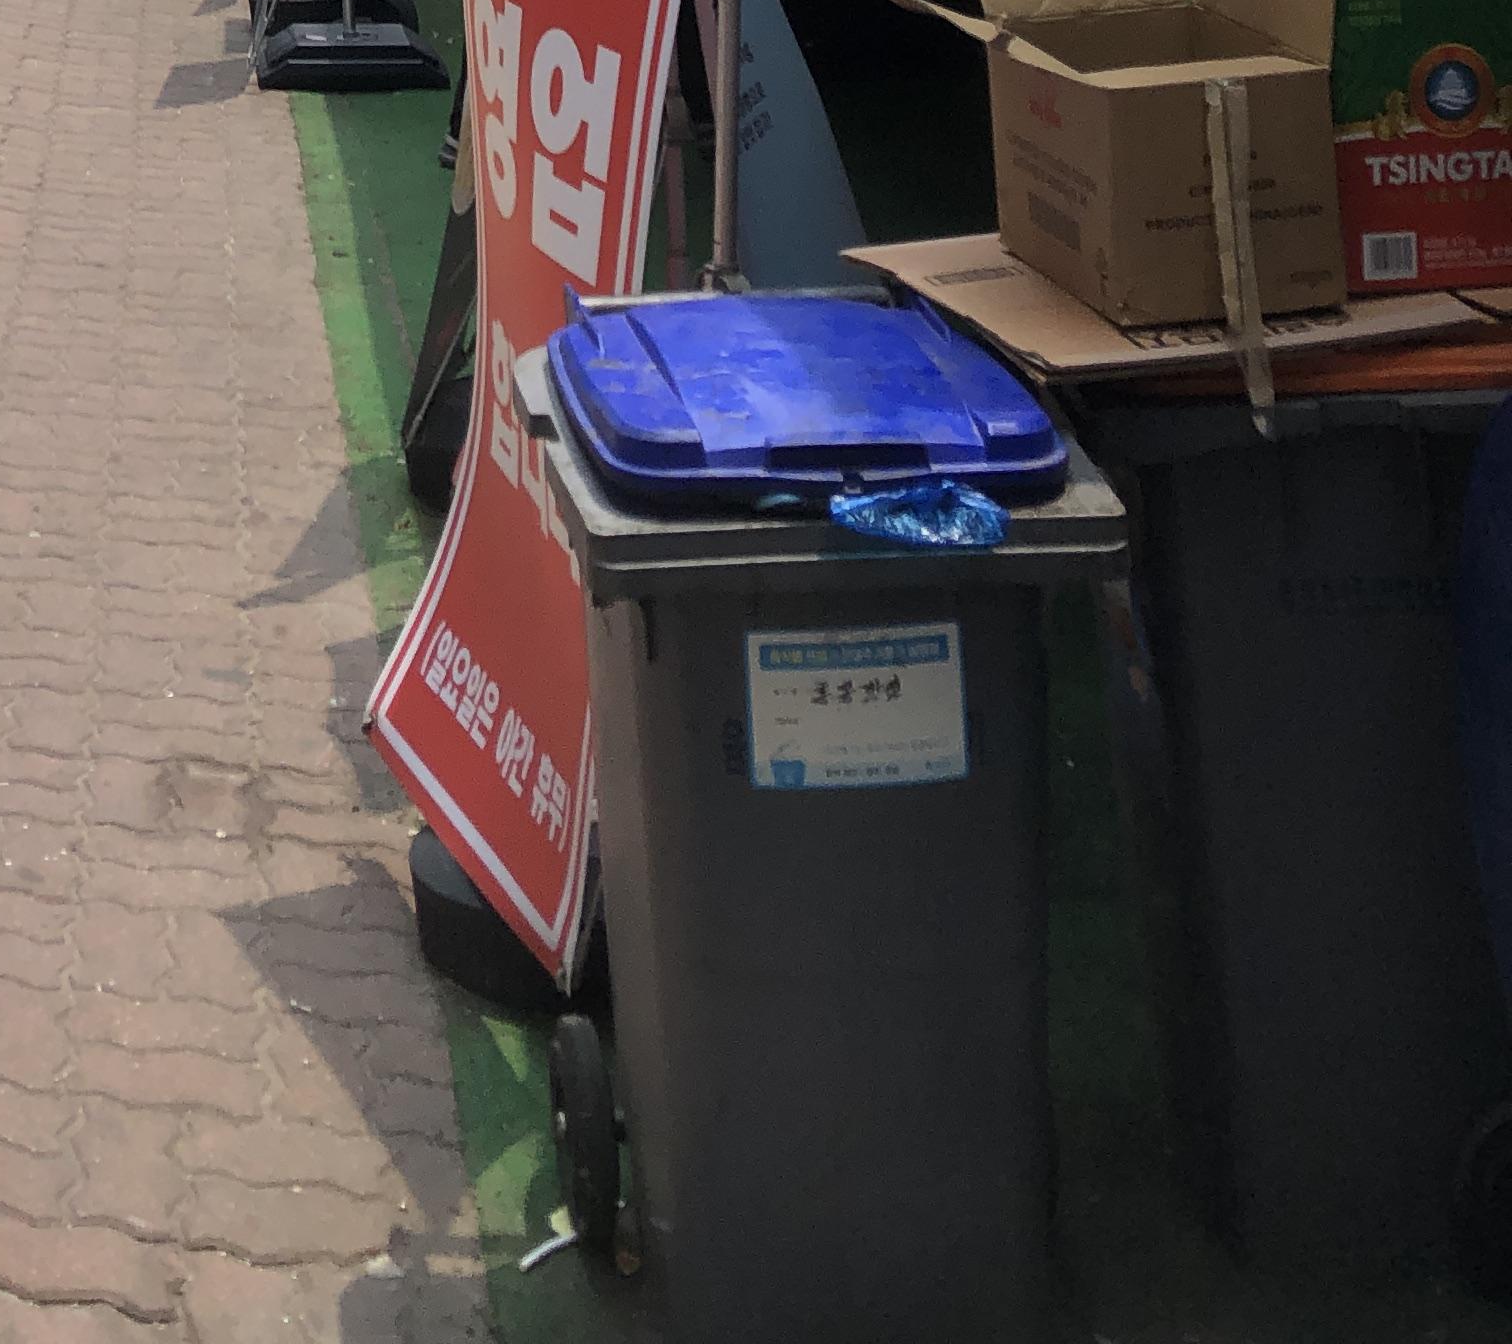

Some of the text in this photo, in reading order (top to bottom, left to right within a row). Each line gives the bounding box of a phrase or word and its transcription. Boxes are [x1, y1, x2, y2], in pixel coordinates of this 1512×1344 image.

[420, 620, 571, 853] (일요일은 야간 휴무)
